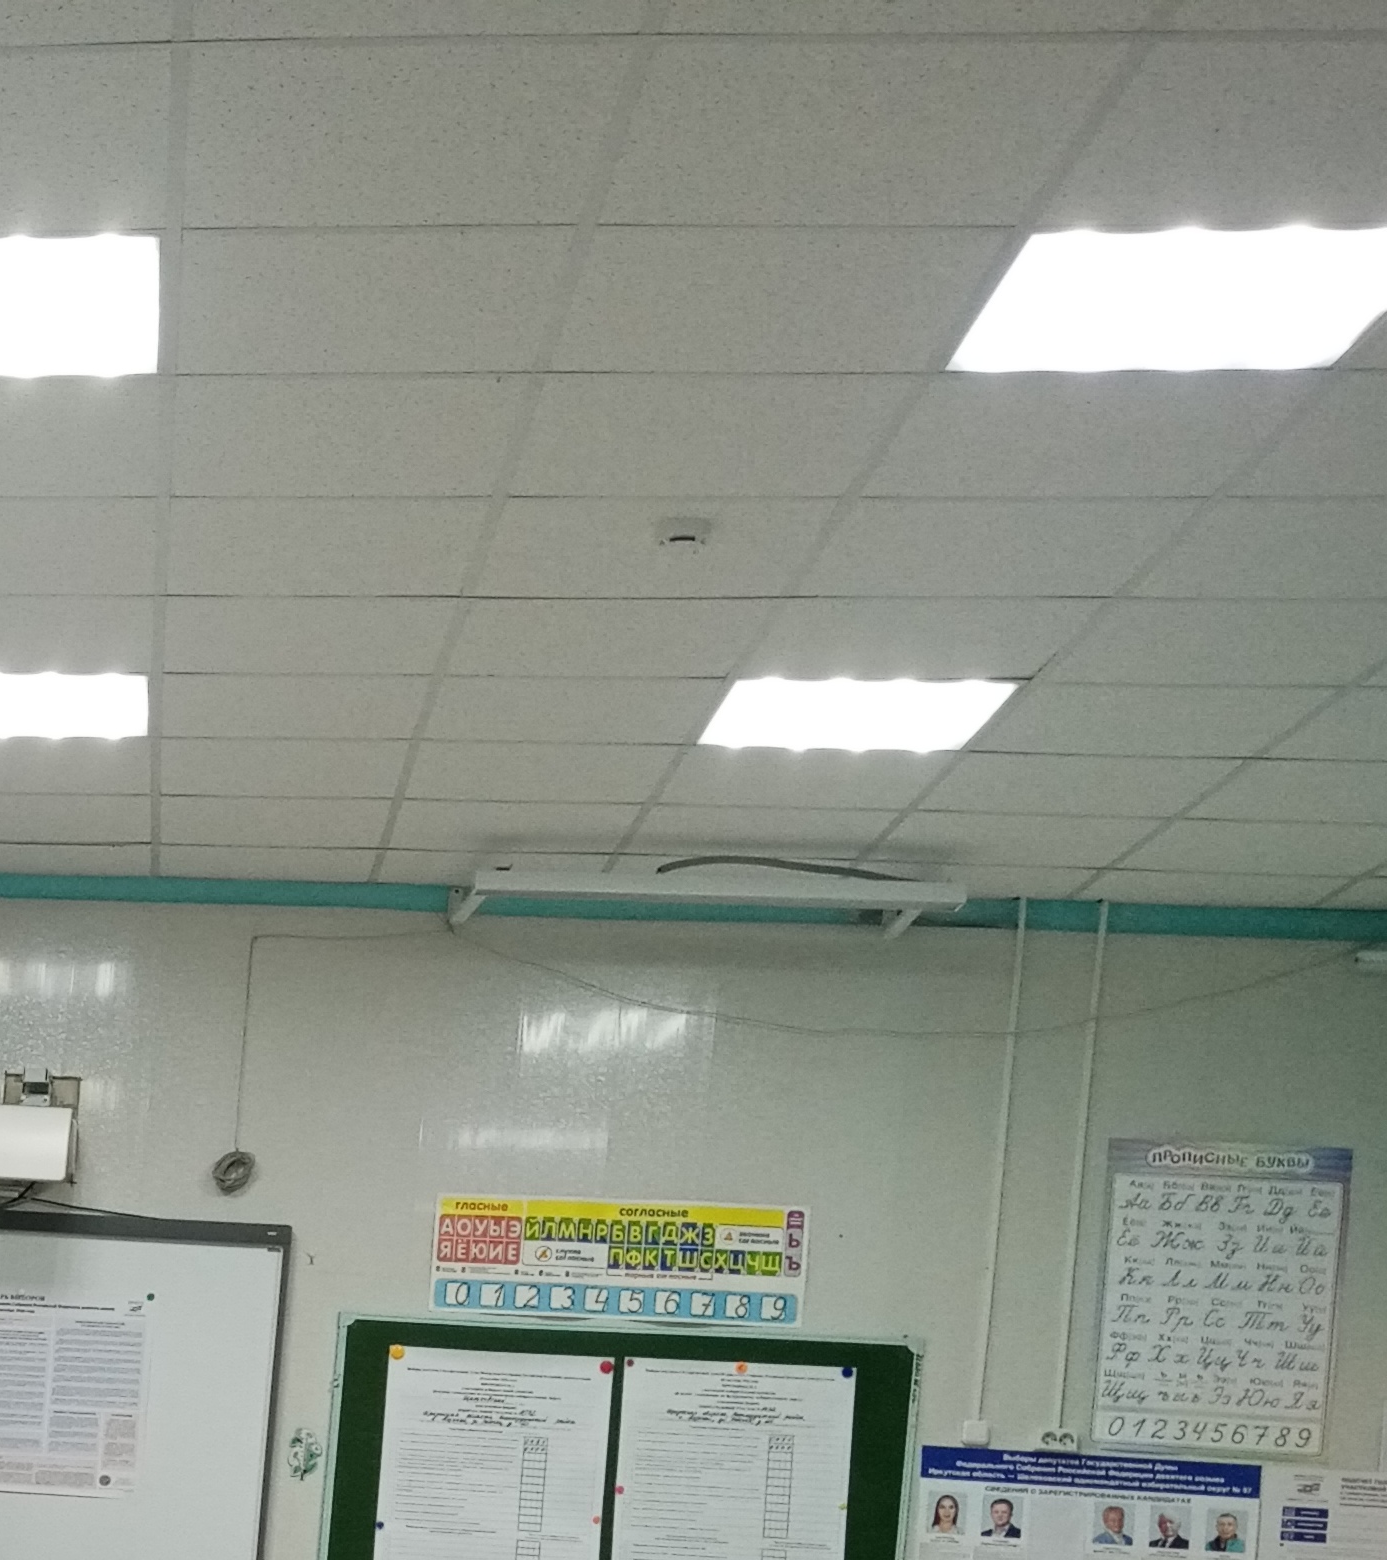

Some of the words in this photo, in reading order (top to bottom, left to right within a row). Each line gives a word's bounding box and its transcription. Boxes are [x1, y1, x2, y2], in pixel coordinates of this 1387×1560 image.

[1152, 1151, 1248, 1167] ПРОПИСНЫЕ
[1255, 1156, 1311, 1168] БУКВЫ
[455, 1201, 509, 1212] гласные
[619, 1206, 689, 1218] согласные
[455, 1282, 469, 1305] 0
[494, 1283, 504, 1307] 1
[526, 1284, 540, 1308] 2
[562, 1285, 575, 1310] 3
[594, 1287, 609, 1312] 4
[628, 1289, 644, 1313] 5
[664, 1291, 679, 1314] 6
[699, 1293, 716, 1316] 7
[735, 1295, 750, 1317] 8
[771, 1296, 786, 1320] 9
